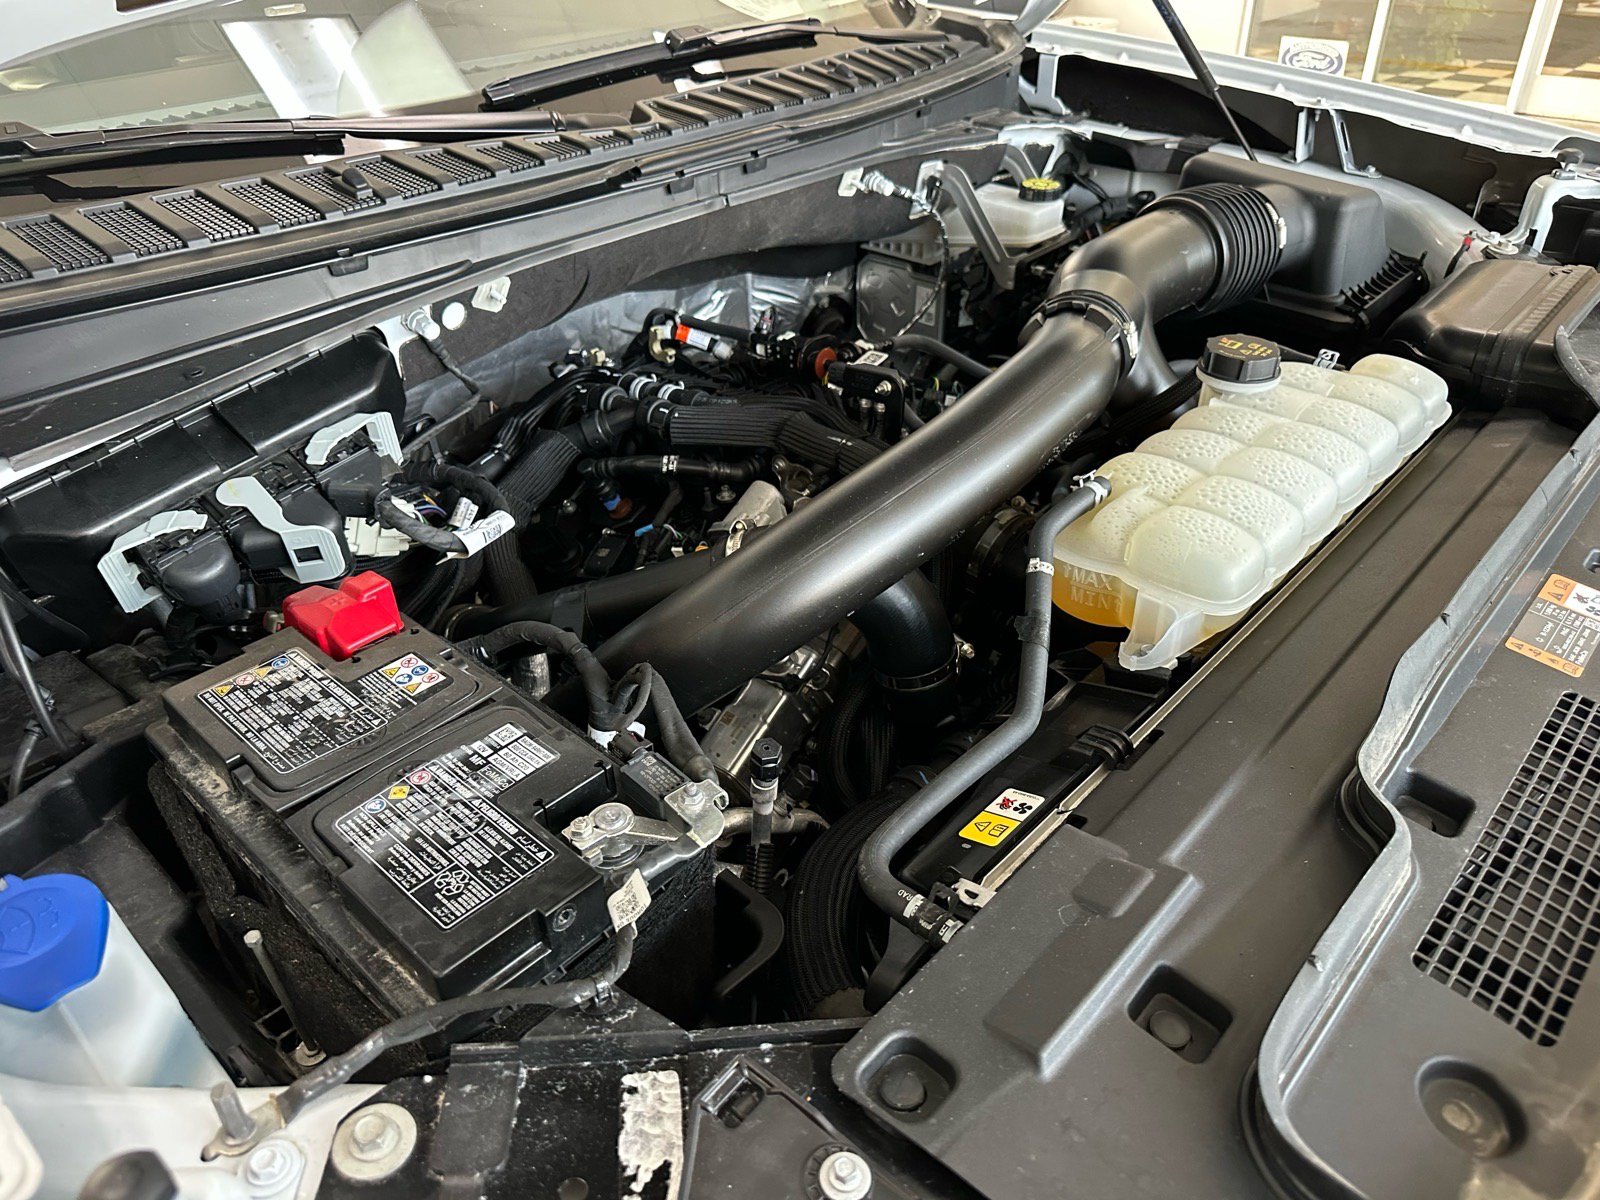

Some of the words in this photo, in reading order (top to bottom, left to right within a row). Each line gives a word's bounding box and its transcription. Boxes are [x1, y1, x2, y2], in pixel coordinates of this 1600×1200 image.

[1072, 567, 1112, 590] MAX
[475, 744, 489, 753] 12V
[467, 754, 488, 767] MF
[516, 761, 530, 770] C20
[480, 766, 511, 788] FoMoCo
[898, 890, 914, 900] RAD
